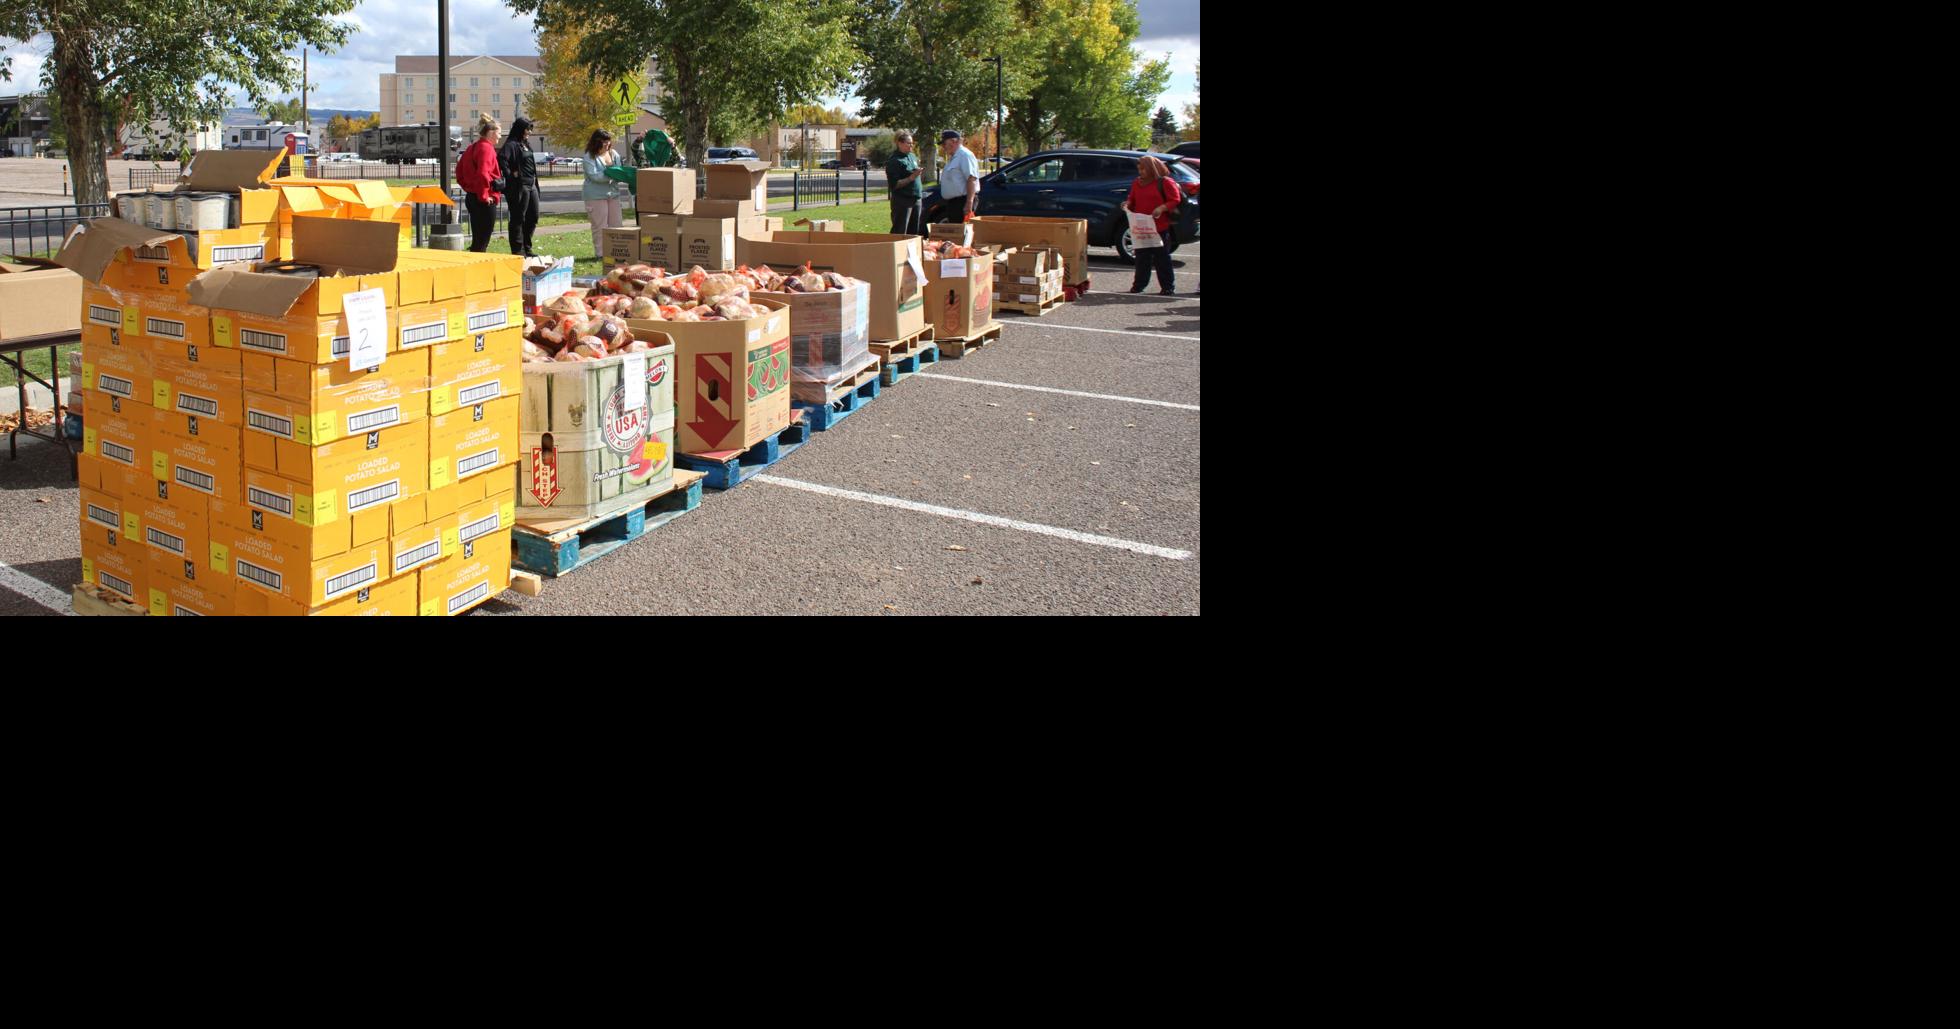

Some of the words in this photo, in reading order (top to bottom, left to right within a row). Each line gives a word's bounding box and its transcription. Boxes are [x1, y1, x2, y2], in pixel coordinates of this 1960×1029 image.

[618, 114, 634, 122] AHEAD
[358, 327, 372, 351] 2
[615, 413, 639, 434] USA
[455, 438, 480, 451] POTATO
[480, 432, 500, 444] SALAD
[465, 427, 490, 440] LOADED
[174, 447, 196, 461] POTATO
[197, 454, 216, 466] SALAD
[183, 441, 206, 455] LOADED
[344, 468, 376, 484] POTATO
[377, 461, 400, 475] SALAD
[357, 456, 388, 471] LOADED
[144, 509, 166, 523] POTATO
[167, 516, 186, 530] SALAD
[153, 503, 176, 518] LOADED
[234, 540, 260, 556] POTATO
[260, 549, 284, 564] SALAD
[245, 535, 272, 551] LOADED
